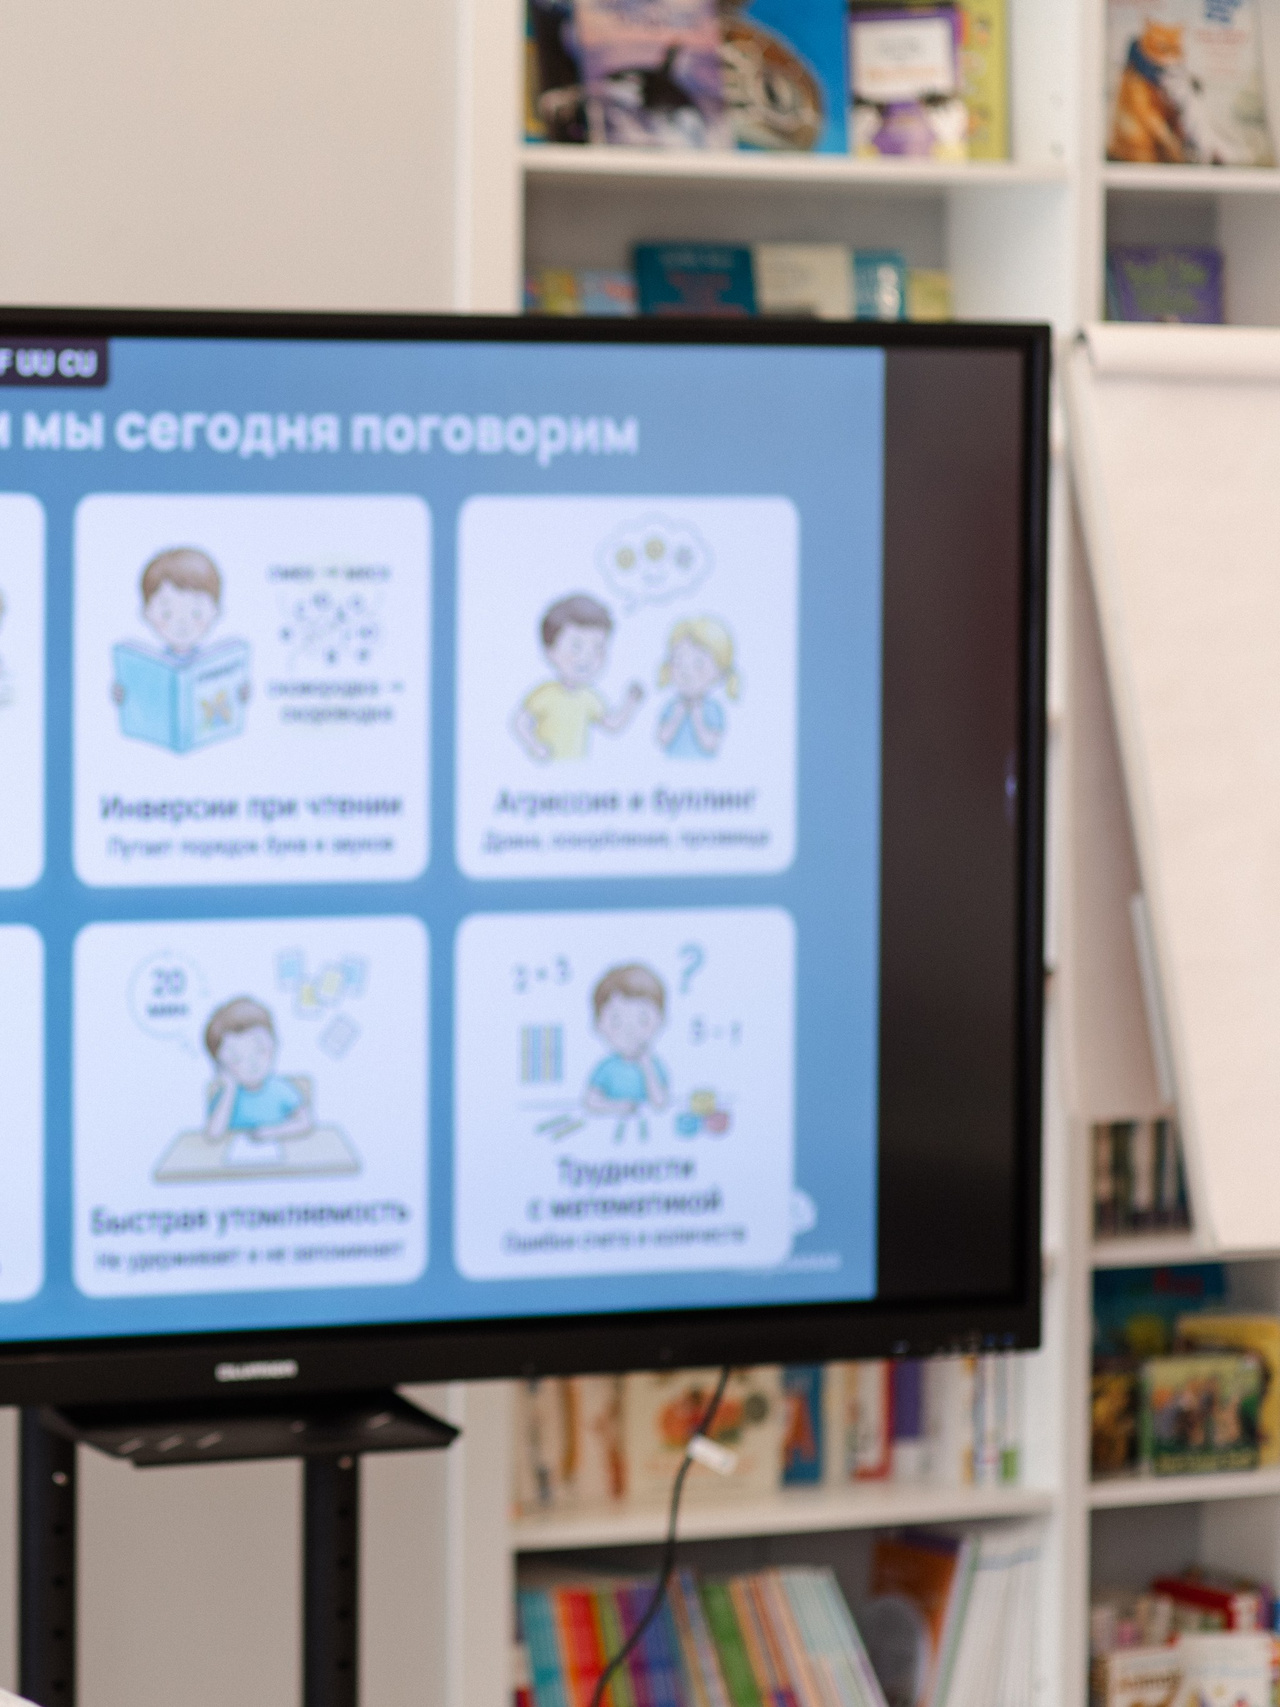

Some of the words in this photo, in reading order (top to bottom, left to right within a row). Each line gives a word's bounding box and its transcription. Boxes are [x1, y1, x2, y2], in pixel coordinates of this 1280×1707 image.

[23, 410, 105, 449] мы
[117, 411, 339, 459] сегодня
[351, 413, 638, 466] поговорим
[99, 796, 240, 826] Инверсии
[250, 798, 300, 824] при
[306, 796, 404, 818] чтении
[496, 788, 621, 820] Агрессия
[629, 792, 644, 812] и
[653, 785, 758, 822] буллинг
[558, 1154, 695, 1190] Трудности
[549, 1184, 723, 1220] математикой
[91, 1206, 208, 1240] Быстрая
[216, 1201, 409, 1238] утомляемость
